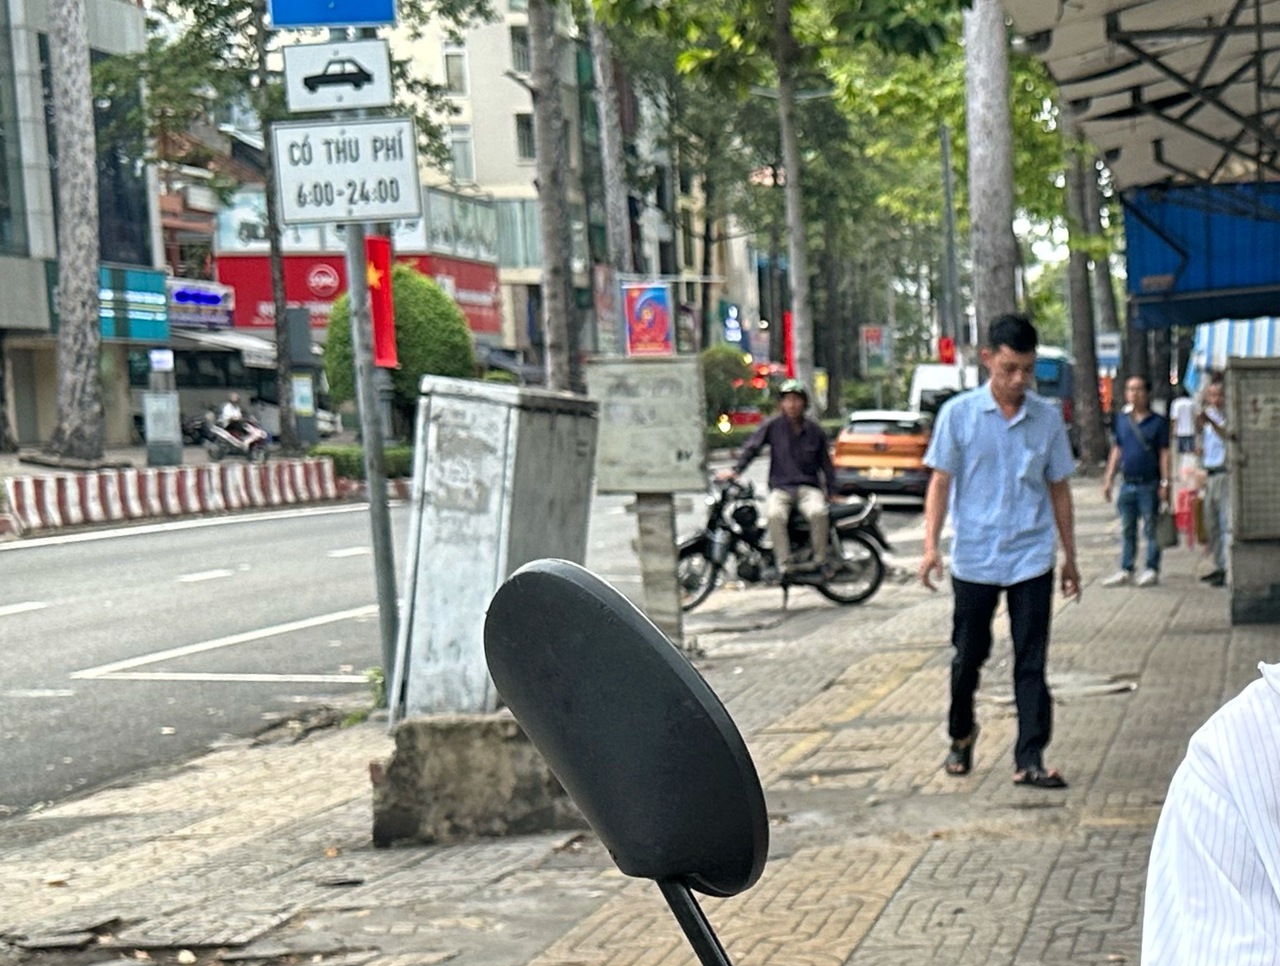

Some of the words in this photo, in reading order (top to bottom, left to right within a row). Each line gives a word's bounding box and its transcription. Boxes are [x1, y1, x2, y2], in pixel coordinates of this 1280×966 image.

[288, 134, 313, 166] CÓ
[323, 137, 360, 164] THU
[372, 127, 404, 162] PHÍ
[297, 177, 400, 208] 6:00-24:00
